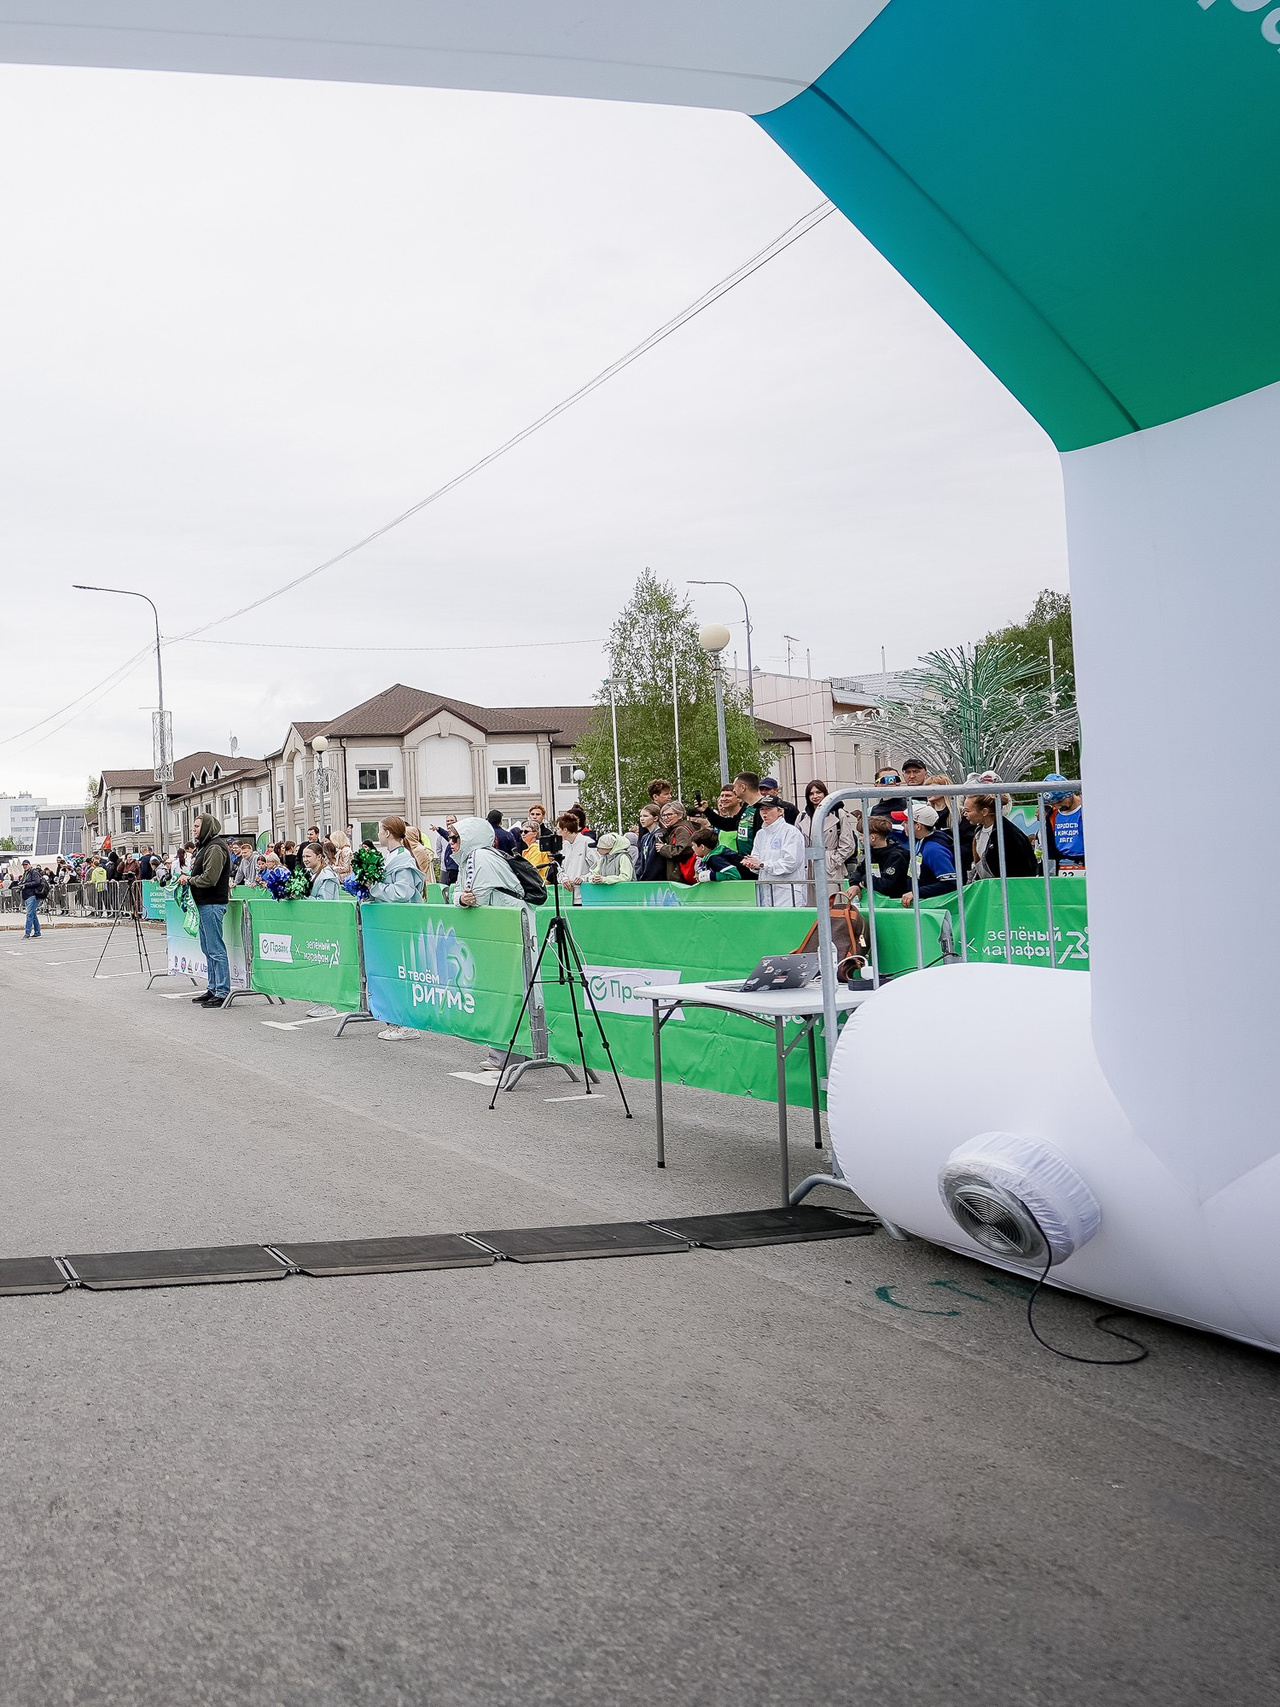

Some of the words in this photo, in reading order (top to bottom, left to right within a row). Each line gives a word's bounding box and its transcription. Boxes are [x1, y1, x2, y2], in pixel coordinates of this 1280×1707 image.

[305, 938, 331, 951] зелёный
[303, 951, 330, 964] марафон
[397, 965, 406, 979] В
[408, 969, 440, 984] твоём
[411, 983, 475, 1014] ритме
